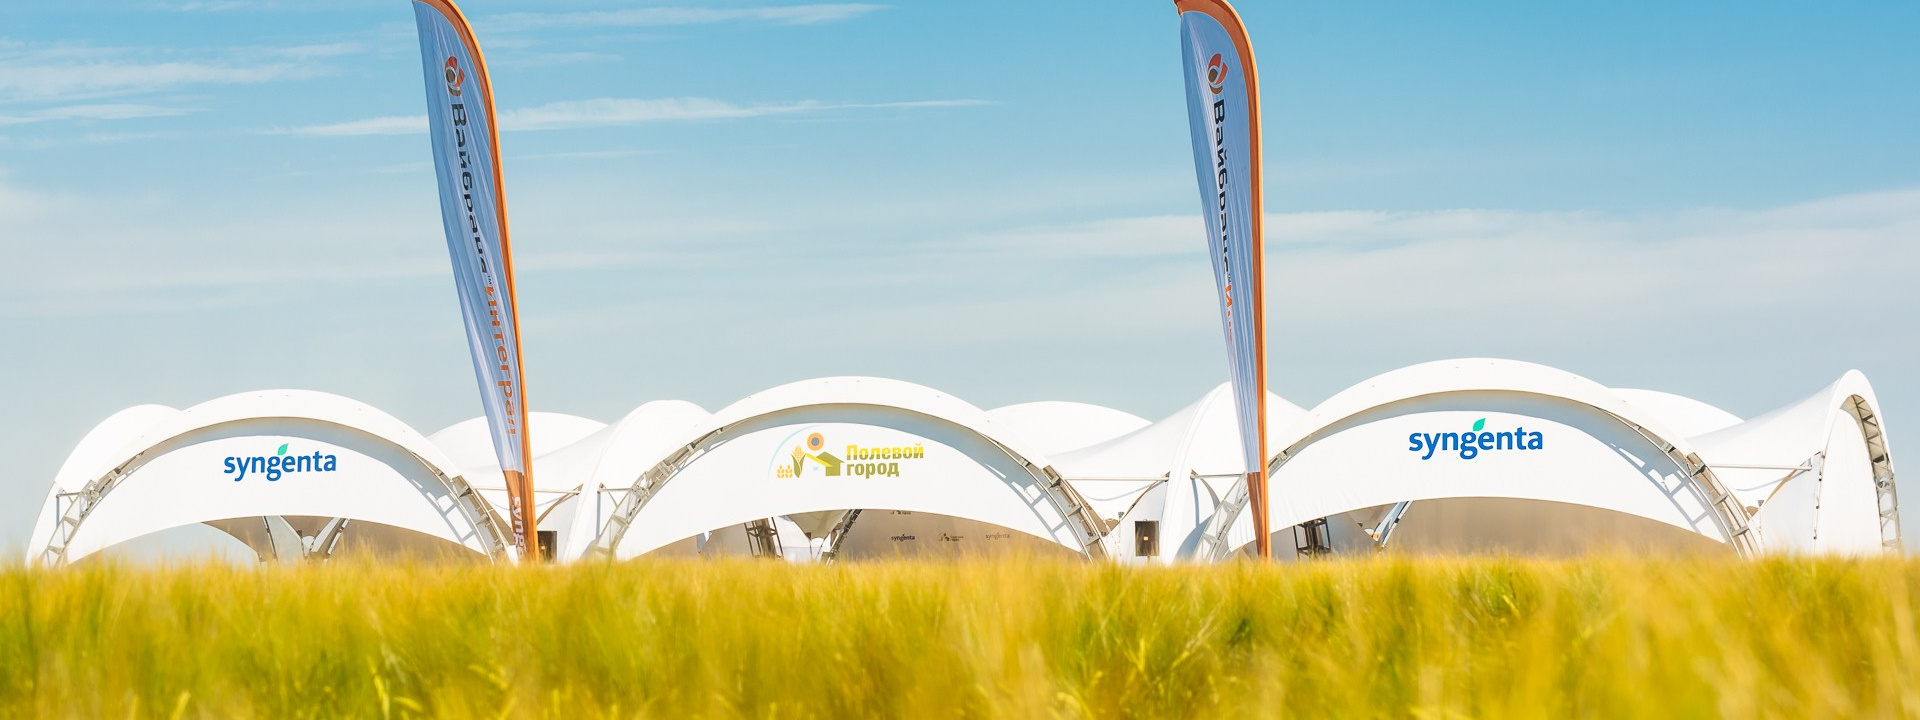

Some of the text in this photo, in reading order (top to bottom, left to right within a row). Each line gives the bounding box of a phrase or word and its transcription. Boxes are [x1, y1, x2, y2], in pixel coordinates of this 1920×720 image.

[846, 443, 924, 460] Полевой
[1409, 427, 1543, 460] syngenta
[224, 451, 337, 482] syngenta
[846, 462, 900, 479] город
[891, 534, 915, 542] syngenta
